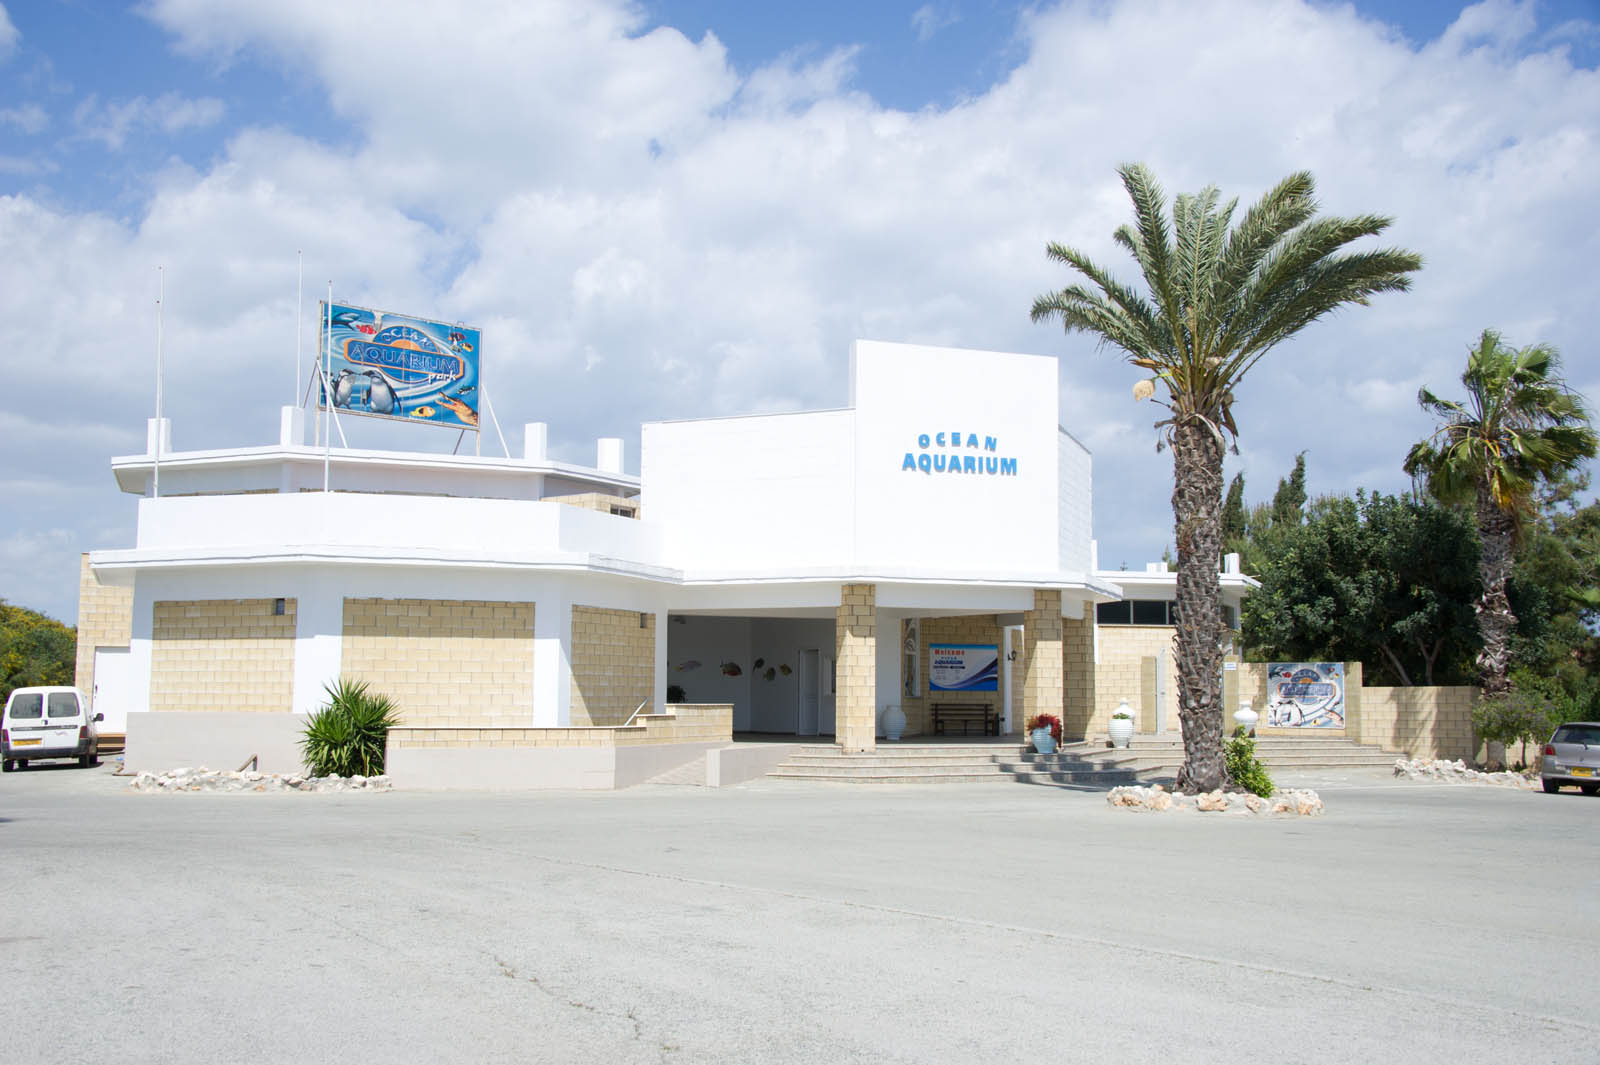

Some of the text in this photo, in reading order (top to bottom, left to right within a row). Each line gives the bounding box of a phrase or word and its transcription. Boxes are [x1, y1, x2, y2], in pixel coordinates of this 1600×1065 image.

[381, 328, 431, 347] OCEAN
[350, 343, 459, 373] AQUARIUM
[428, 371, 457, 384] park
[918, 431, 997, 452] OCEAN
[901, 452, 1017, 476] AQUARIUM
